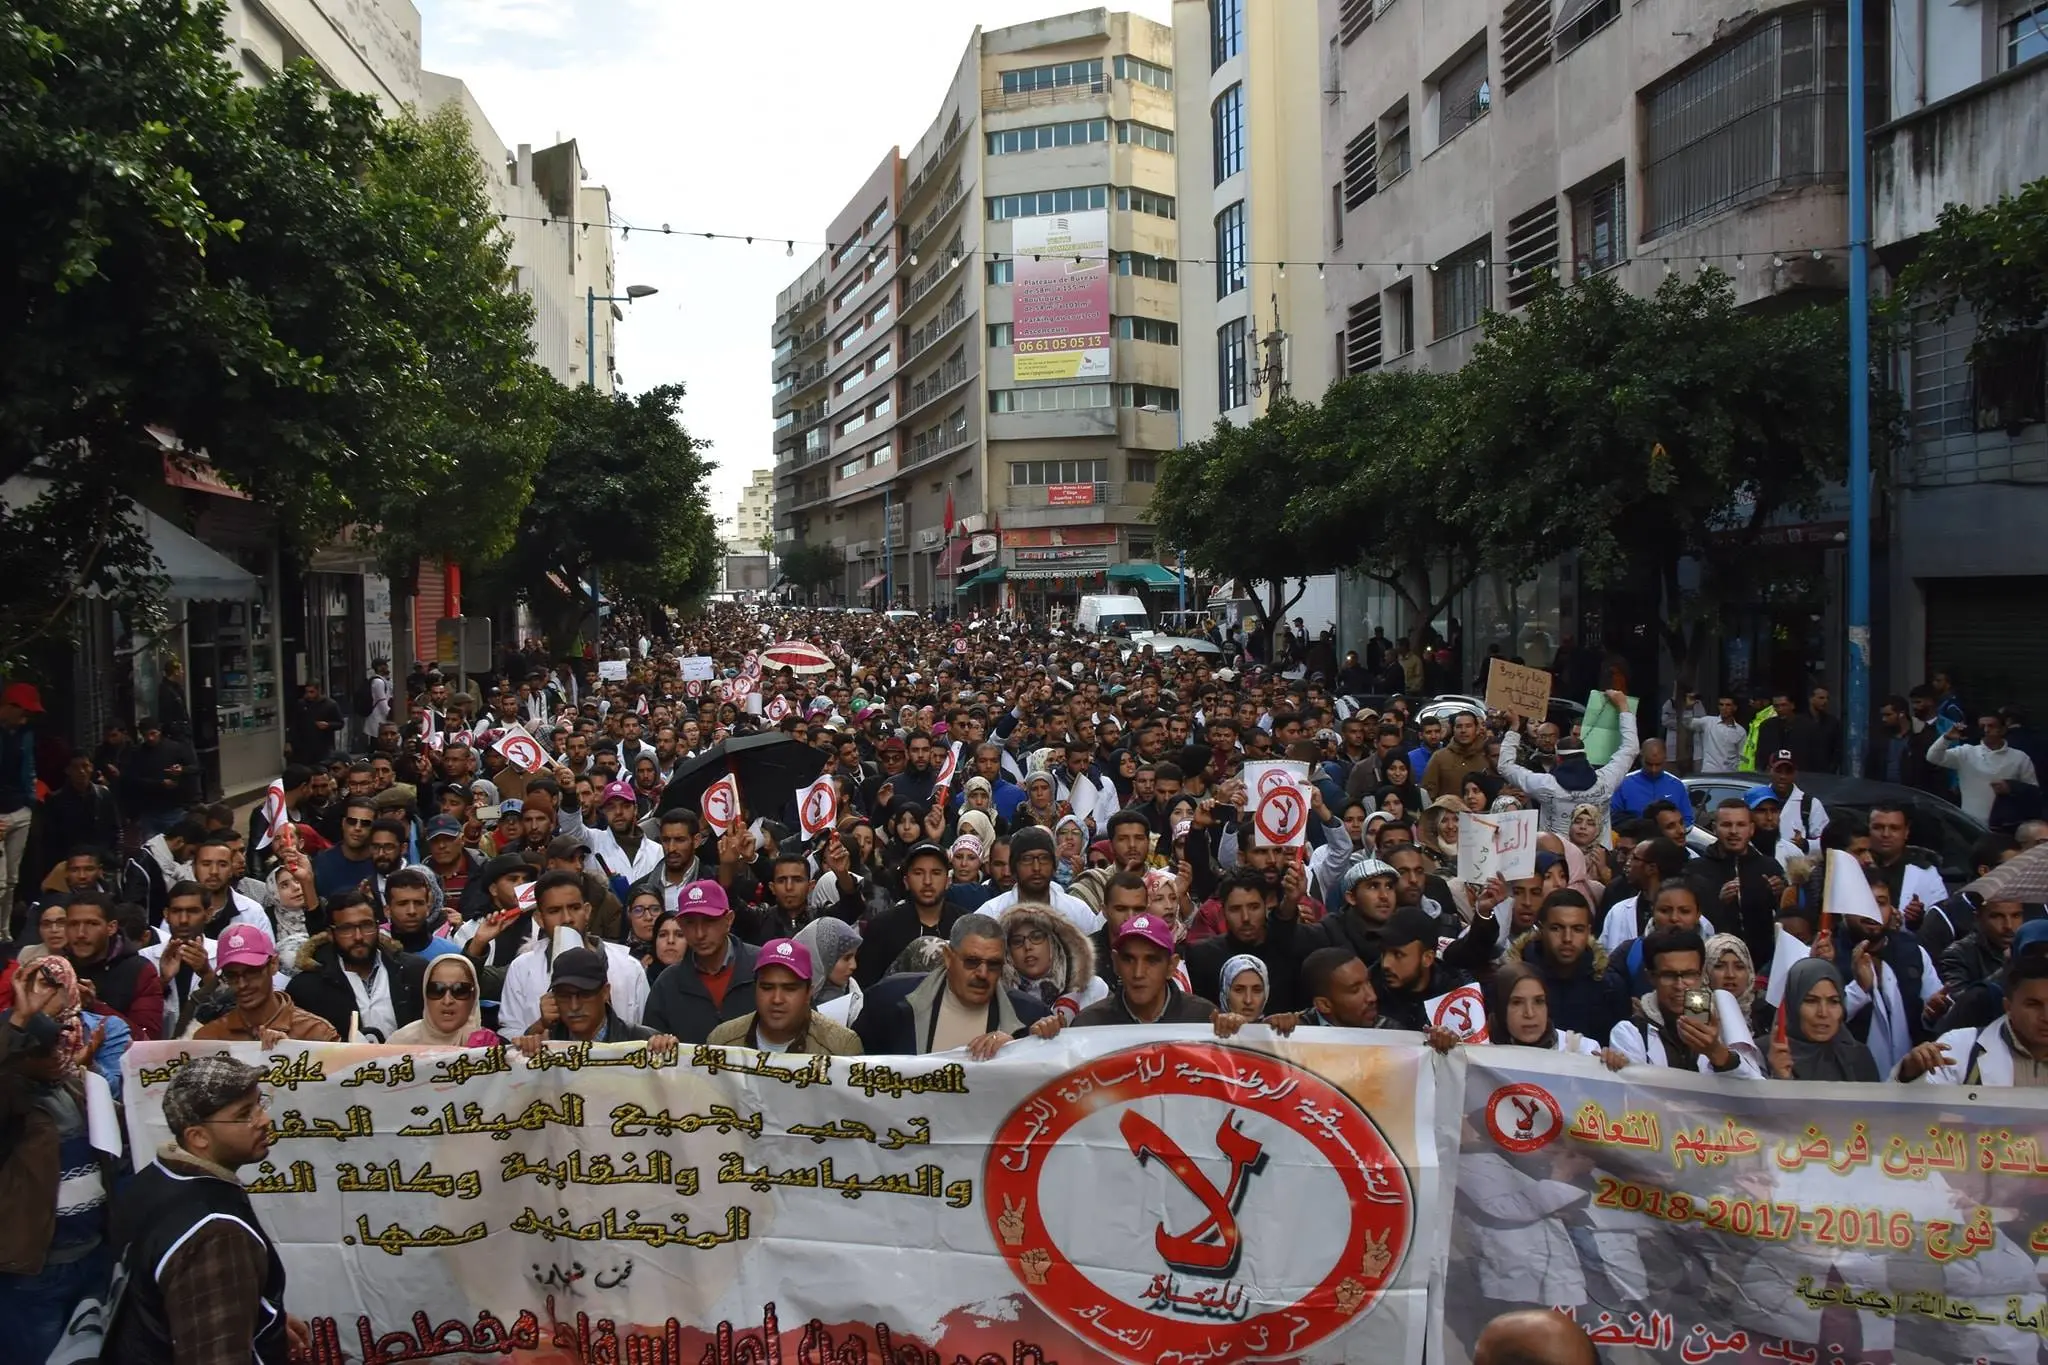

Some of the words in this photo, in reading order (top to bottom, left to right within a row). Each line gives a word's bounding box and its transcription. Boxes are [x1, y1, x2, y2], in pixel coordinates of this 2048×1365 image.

[1019, 341, 1034, 352] 06
[1036, 340, 1049, 351] 61
[1052, 338, 1067, 349] 05
[1070, 337, 1085, 348] 05
[1087, 335, 1102, 347] 13
[880, 722, 888, 730] A
[257, 1050, 326, 1090] عليه
[341, 1055, 415, 1088] فرض
[1056, 1054, 1165, 1103] للأساتذة
[1175, 1062, 1299, 1101] الوطنية
[397, 1092, 585, 1141] الهيئات
[609, 1102, 763, 1140] بجميع
[787, 1116, 931, 1150] ترحب
[1000, 1097, 1058, 1172] الذين
[1568, 1103, 1660, 1151] التعاقد
[1294, 1098, 1403, 1204] التنسيقية
[1672, 1118, 1760, 1169] عليهم
[1776, 1121, 1871, 1175] فرض
[1882, 1126, 1968, 1178] الذين
[1976, 1129, 2048, 1174] اتذة
[338, 1159, 482, 1200] وكافة
[500, 1149, 699, 1196] والنقابية
[718, 1151, 973, 1209] والسياسية
[1119, 1107, 1266, 1273] لا
[1924, 1207, 1994, 1263] فوج
[1139, 1273, 1247, 1318] للتعاقد
[1796, 1275, 1901, 1317] اجتماعية
[2004, 1296, 2048, 1334] امة
[1069, 1304, 1153, 1350] التعاقد
[1244, 1313, 1310, 1352] فرض
[1680, 1323, 1750, 1364] من
[1155, 1337, 1232, 1365] عليهم
